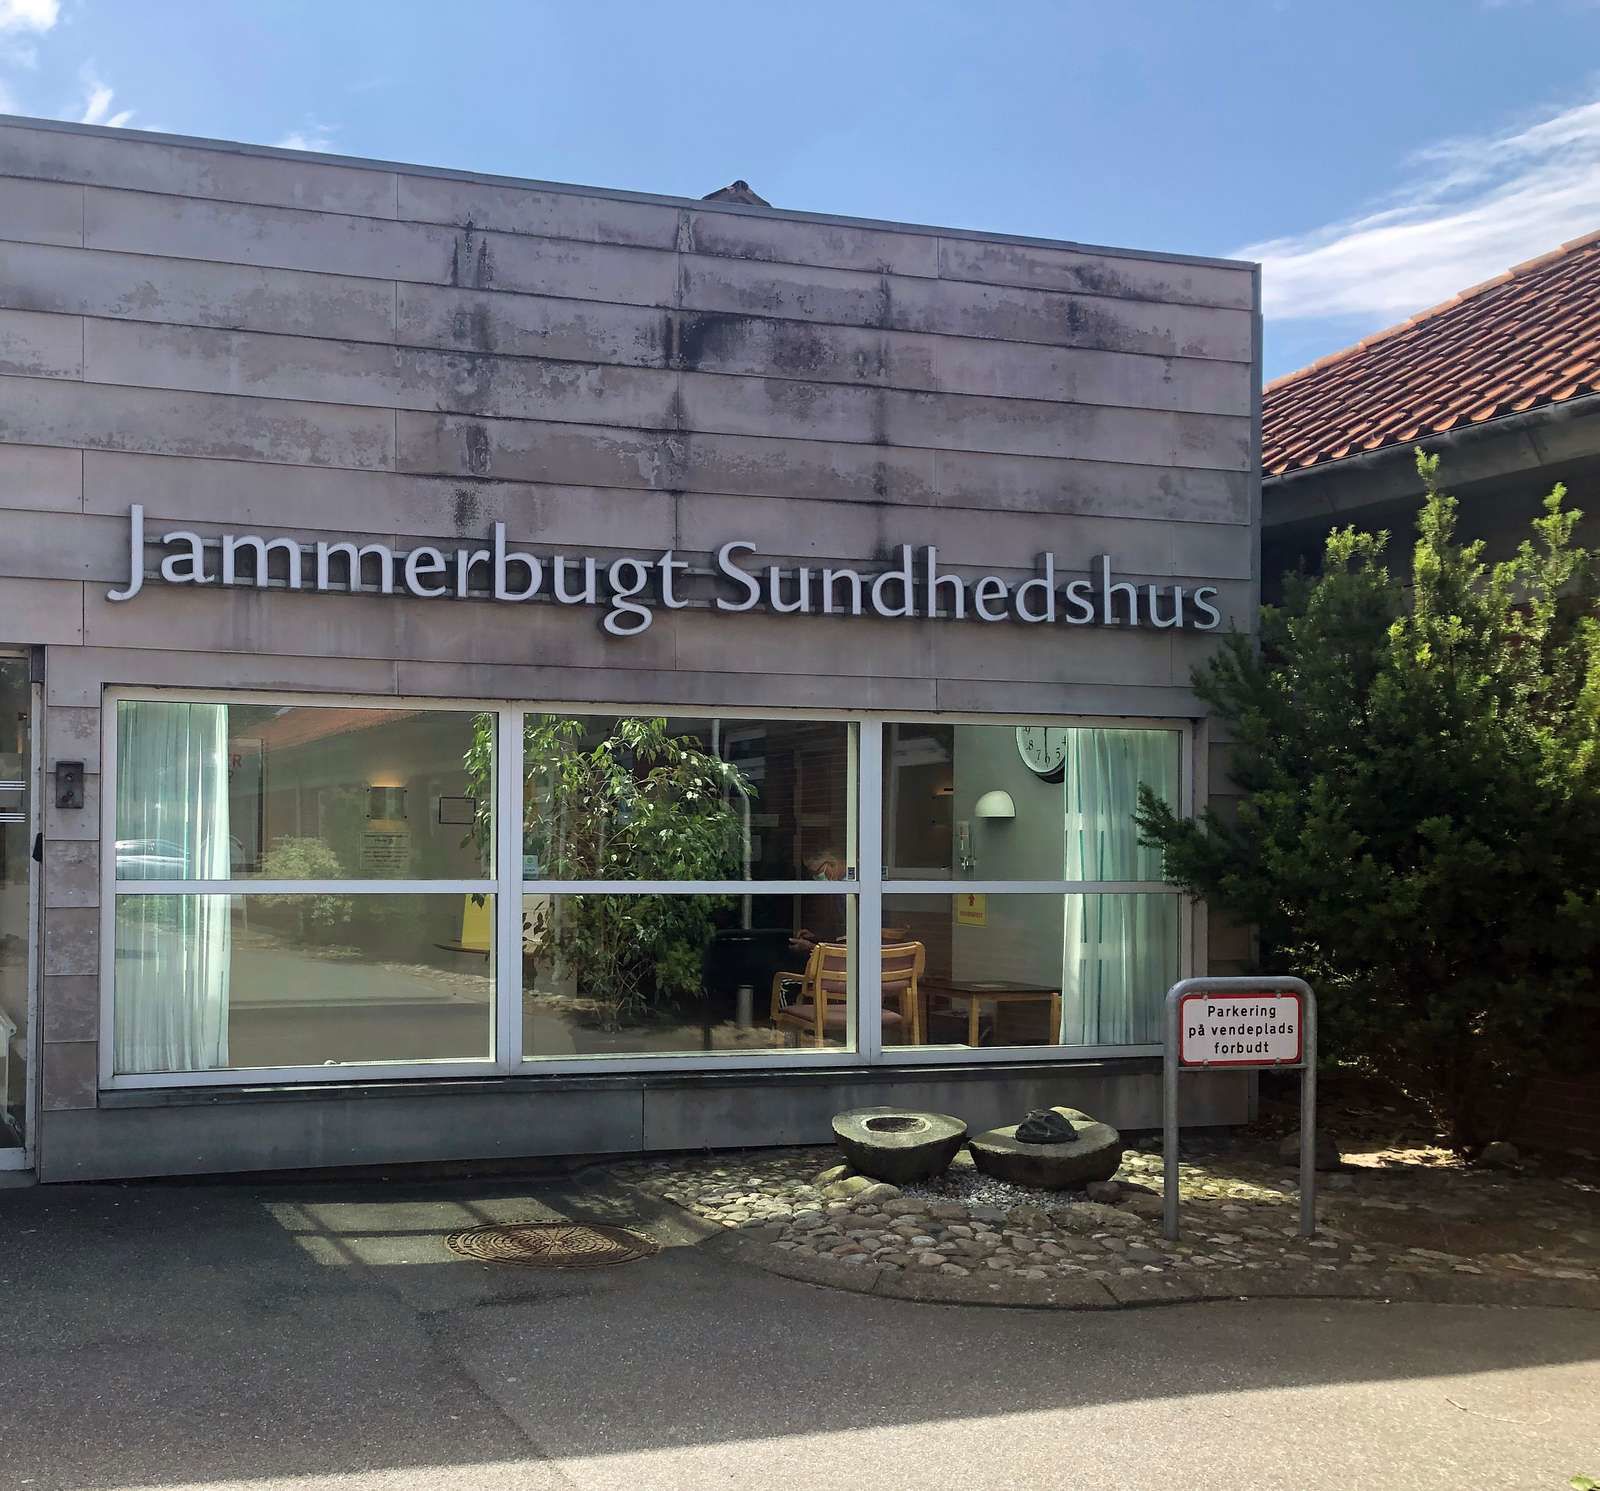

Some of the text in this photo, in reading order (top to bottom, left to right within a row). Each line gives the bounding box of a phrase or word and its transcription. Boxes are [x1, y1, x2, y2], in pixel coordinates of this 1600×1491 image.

[106, 503, 1222, 637] Jammerbugt Sundhedshus
[1207, 1005, 1276, 1018] Parkering
[1188, 1022, 1294, 1039] på vendeplads
[1214, 1041, 1270, 1055] forbudt
